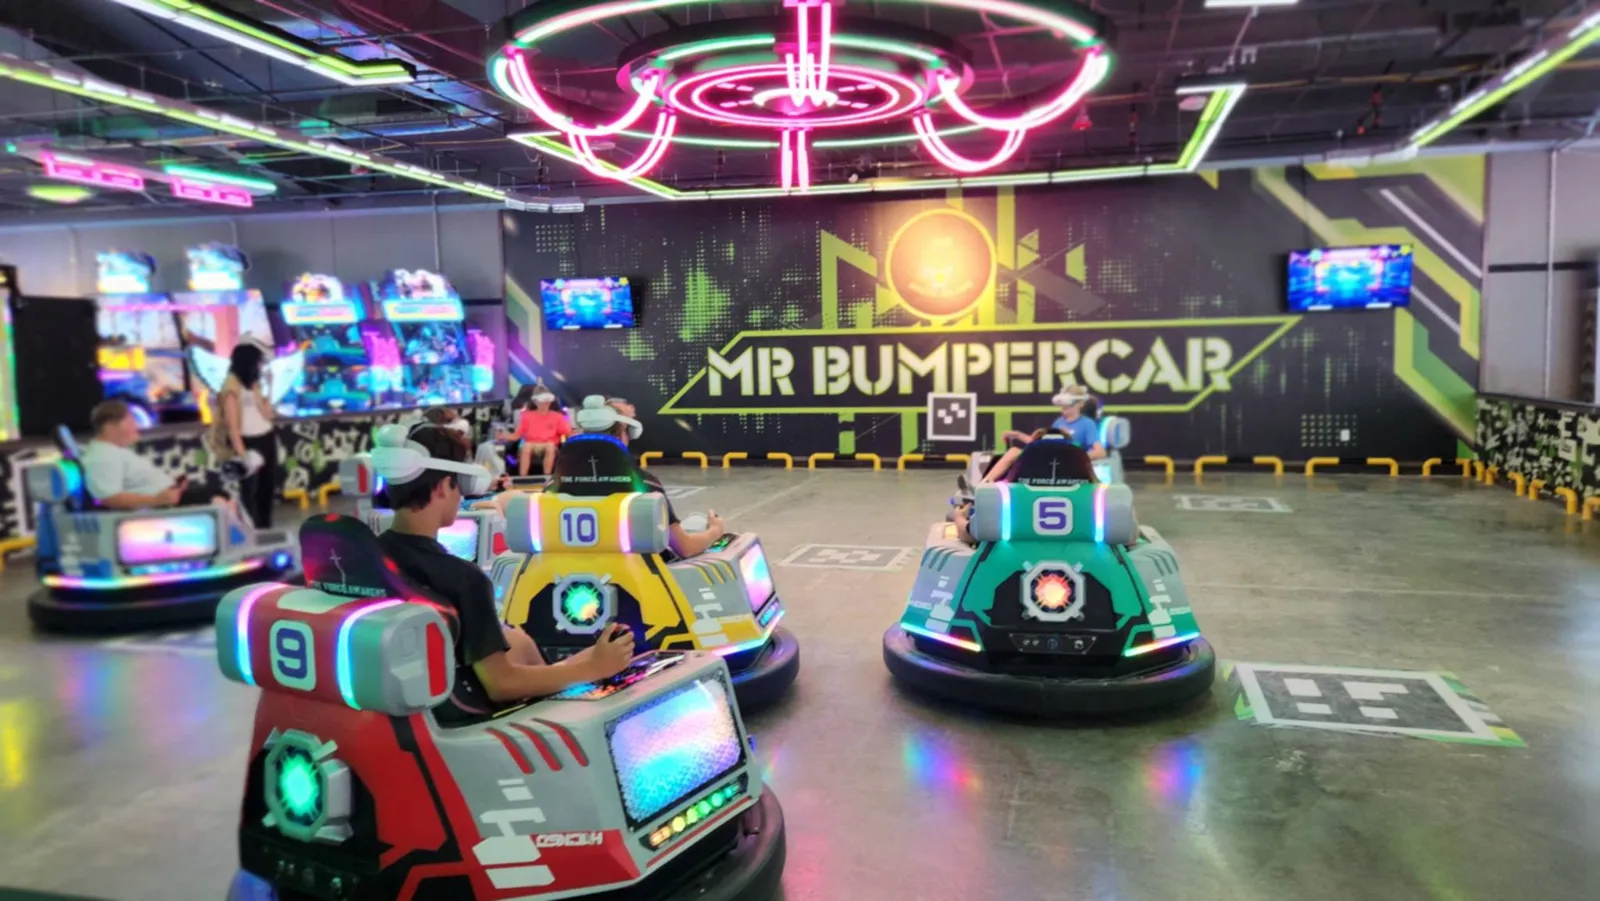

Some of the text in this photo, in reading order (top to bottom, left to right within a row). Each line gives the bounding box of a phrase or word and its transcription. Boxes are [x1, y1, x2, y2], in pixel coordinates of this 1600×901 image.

[708, 336, 1232, 396] MR BUMPERCAR
[560, 475, 573, 484] THE
[563, 512, 595, 542] 10
[1039, 501, 1067, 530] 5
[276, 627, 308, 680] 9
